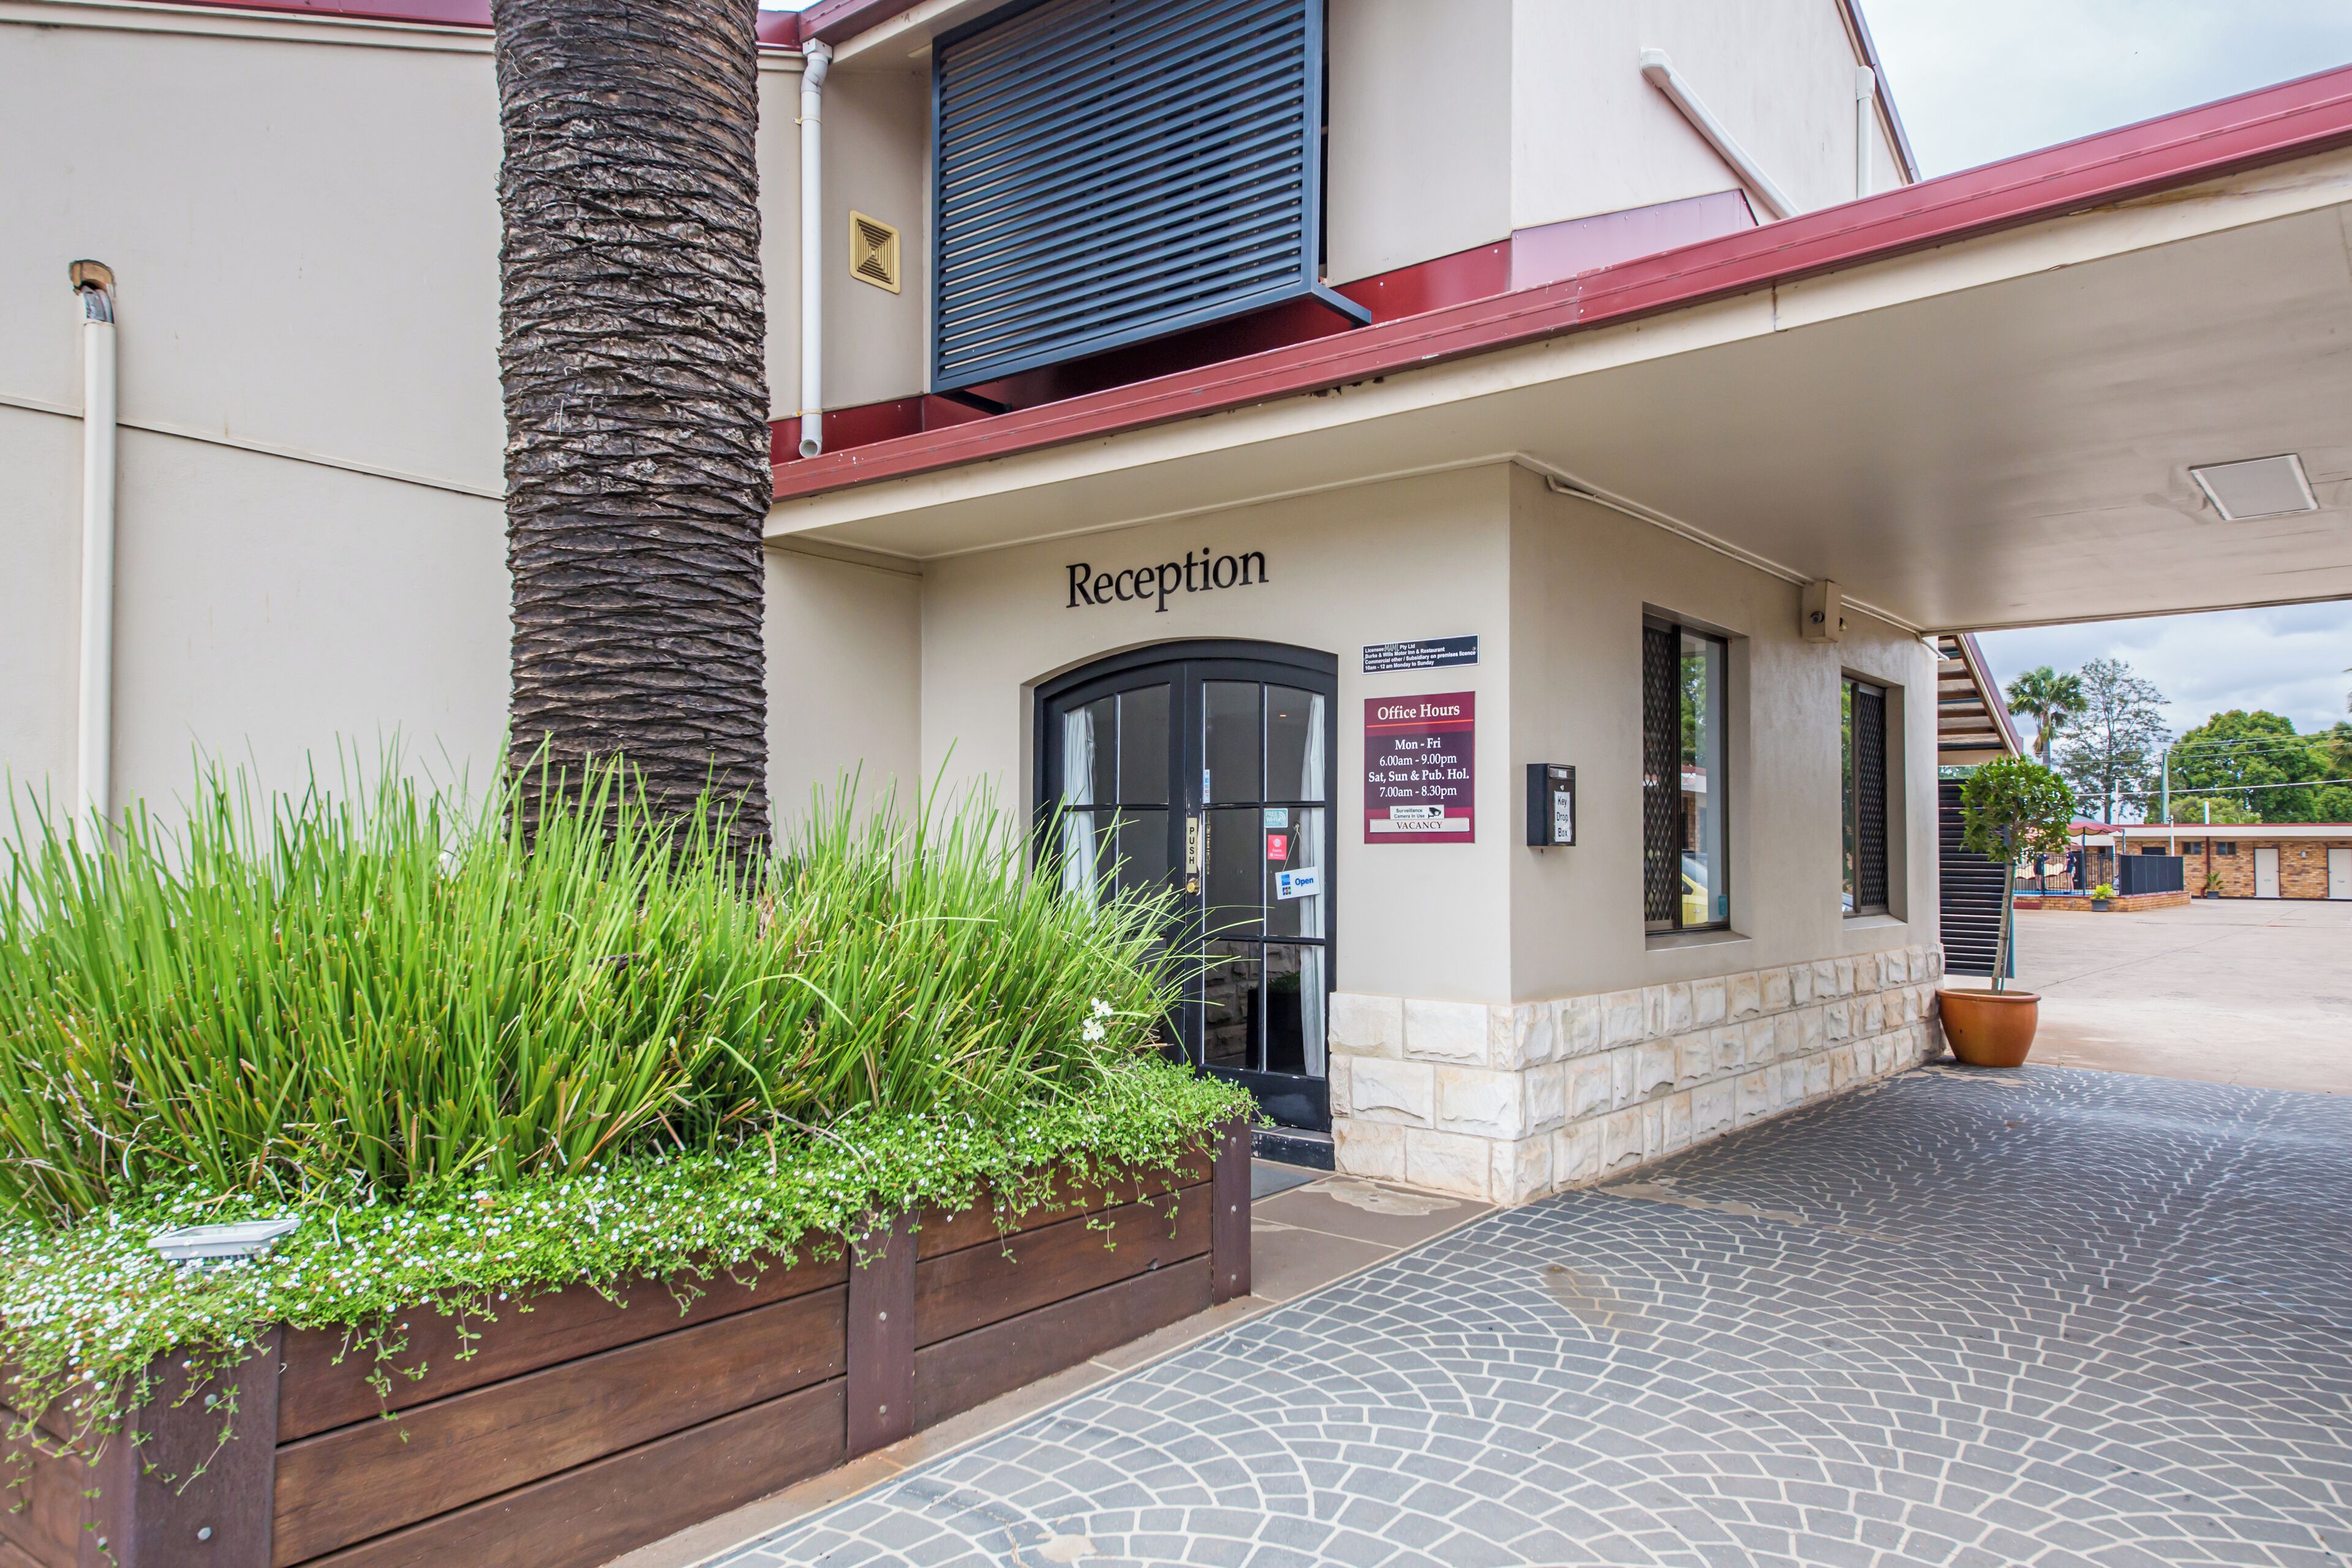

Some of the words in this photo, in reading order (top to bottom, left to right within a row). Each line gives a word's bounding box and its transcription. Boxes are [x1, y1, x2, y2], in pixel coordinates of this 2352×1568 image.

[1066, 547, 1269, 612] Reception
[1378, 706, 1416, 720] Office
[1420, 704, 1460, 717] Hours
[1395, 739, 1418, 750] Mon
[1427, 737, 1441, 748] Fri
[1379, 755, 1413, 766] 6.00am
[1421, 753, 1457, 767] 9.00pm
[1368, 772, 1387, 783] Sat,
[1389, 771, 1408, 782] Sun
[1411, 771, 1420, 781] &
[1422, 769, 1445, 780] Pub.
[1447, 767, 1469, 779] Hol.
[1379, 786, 1413, 797] 7.00am
[1421, 785, 1457, 799] 8.30pm
[1558, 796, 1567, 808] Key
[1557, 812, 1568, 823] Drop
[1396, 821, 1442, 829] VACANCY
[1558, 828, 1567, 837] Box
[1295, 878, 1313, 886] Open
